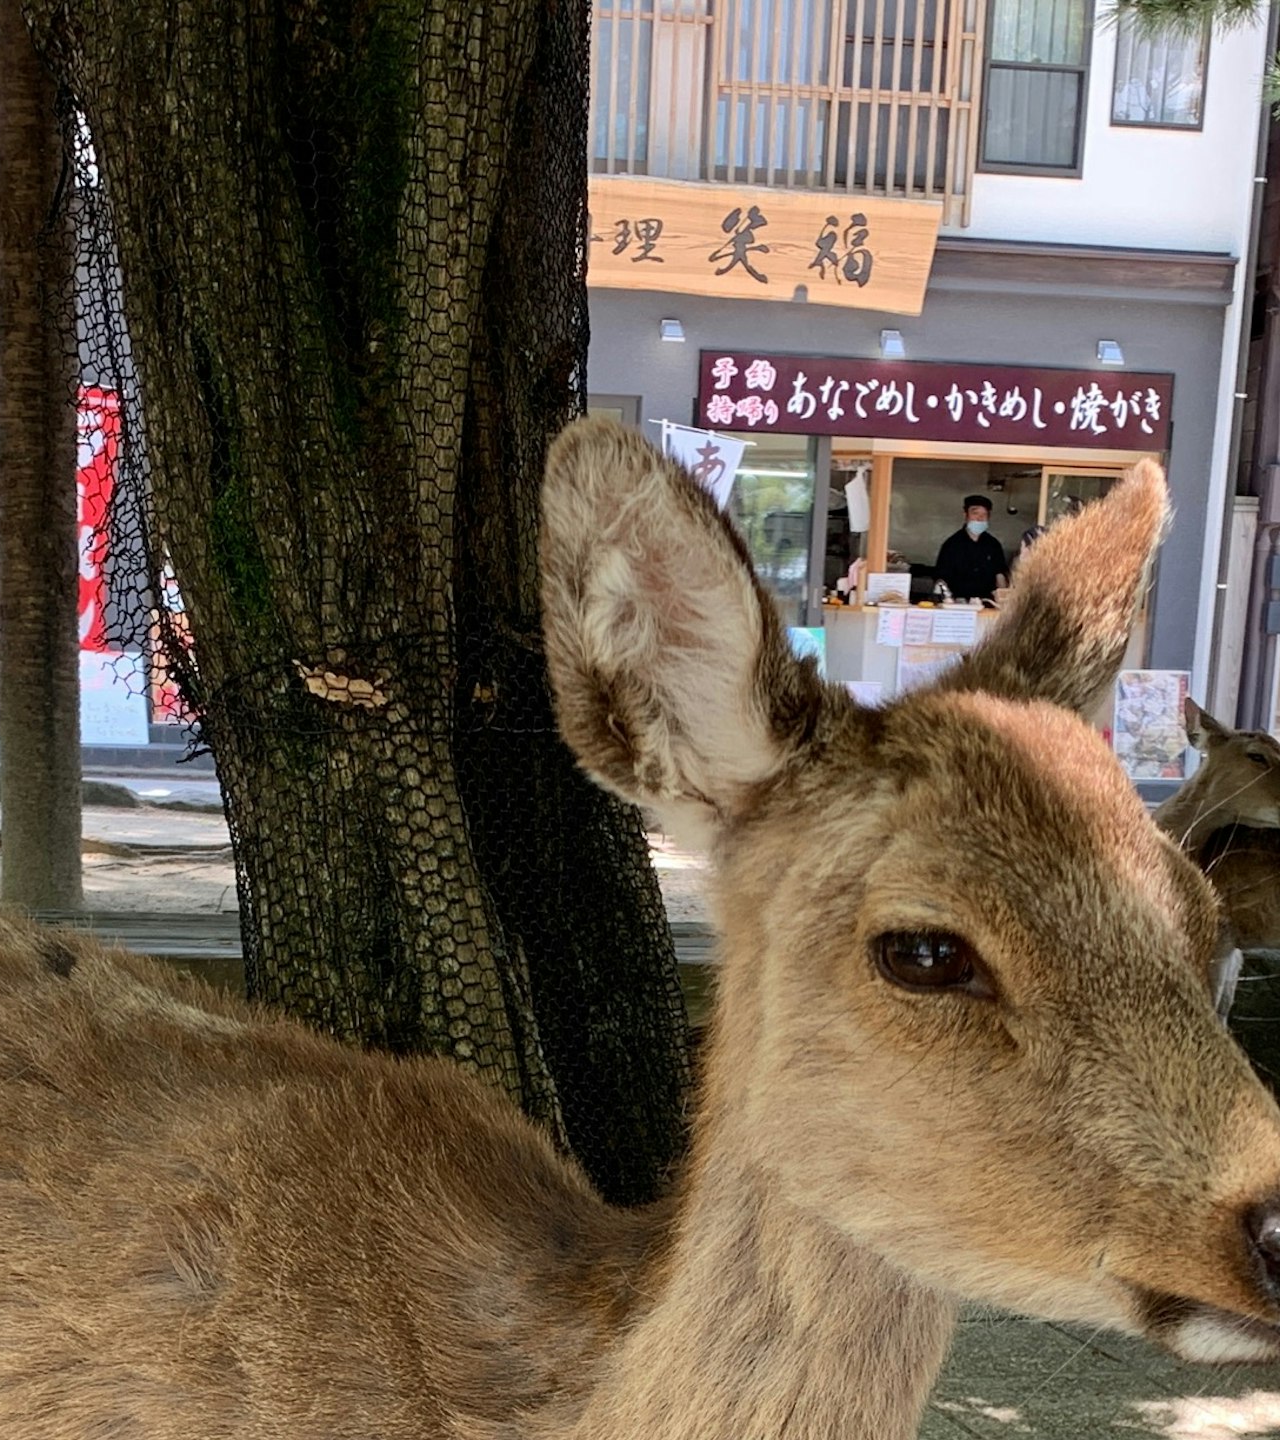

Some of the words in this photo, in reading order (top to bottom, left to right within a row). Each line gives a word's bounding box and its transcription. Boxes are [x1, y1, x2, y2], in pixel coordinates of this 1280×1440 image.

[712, 357, 777, 391] 予約
[706, 394, 779, 426] 持帰り
